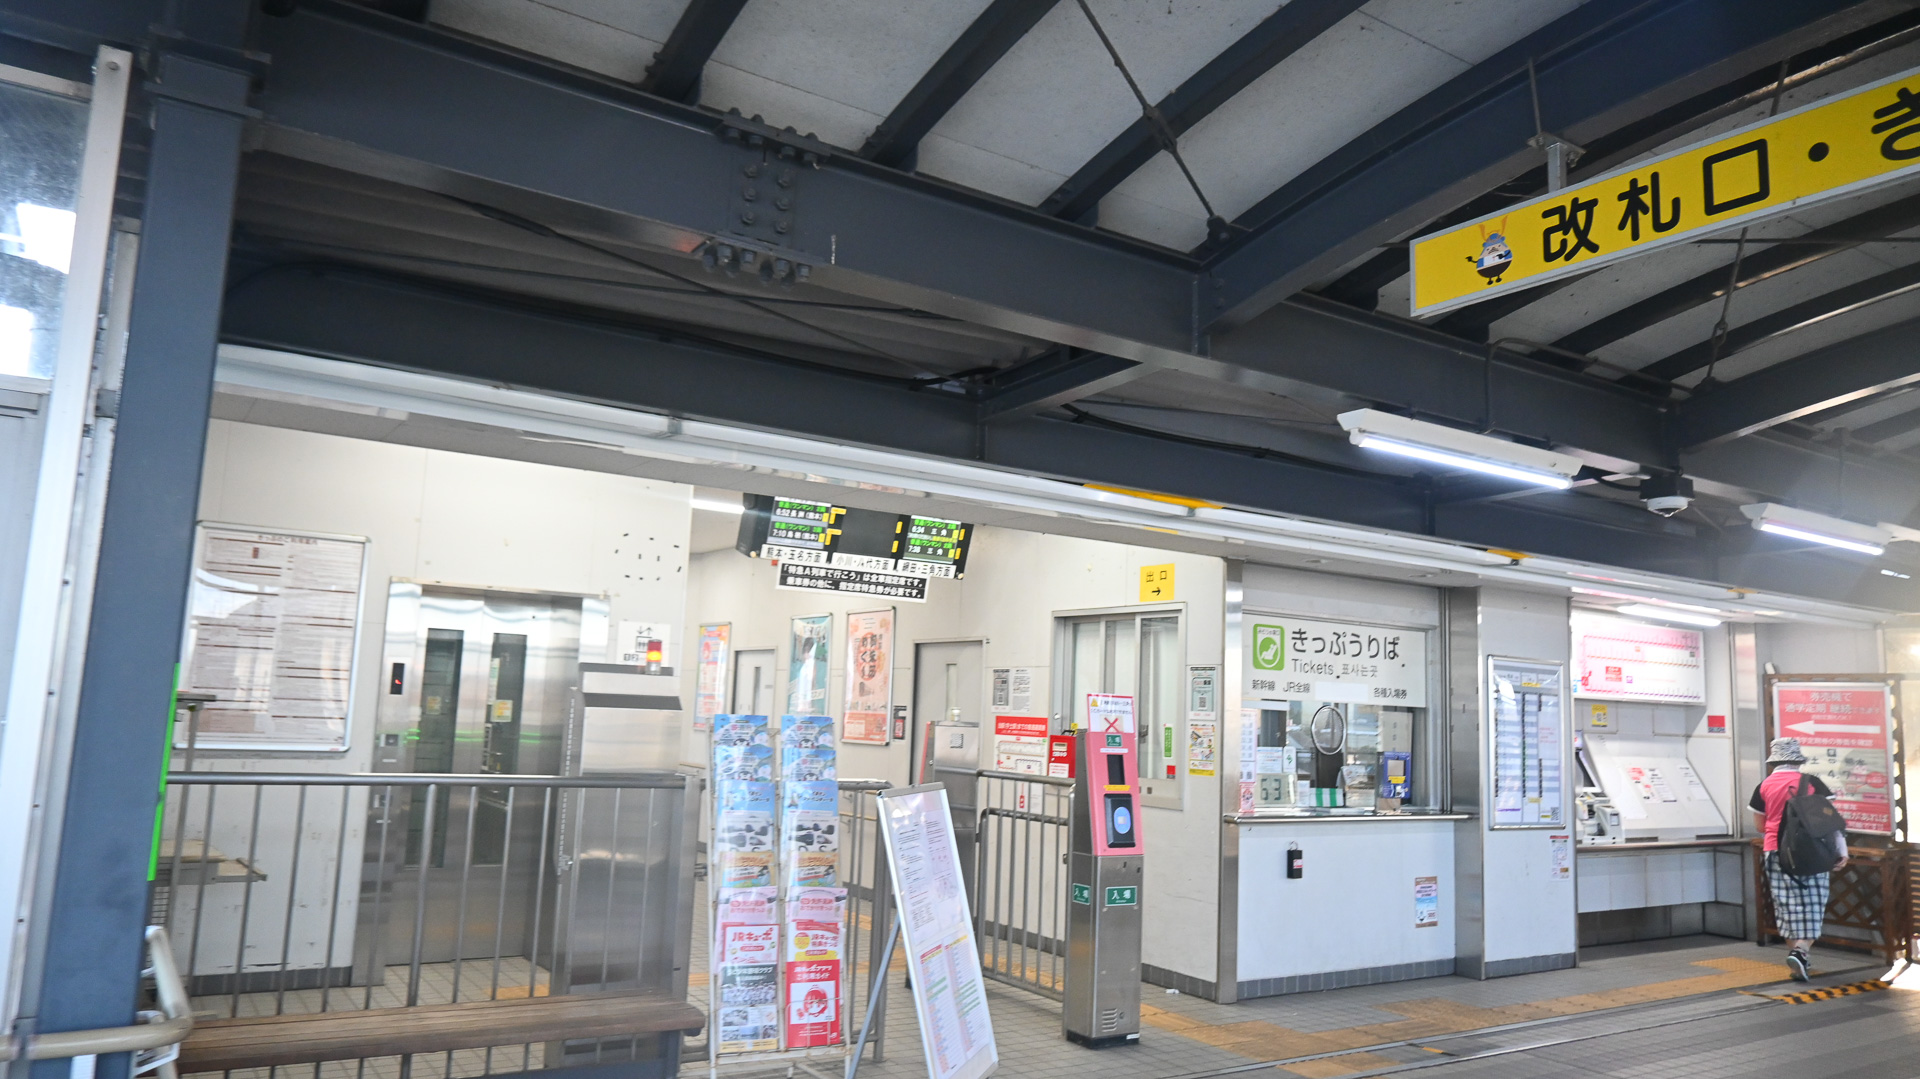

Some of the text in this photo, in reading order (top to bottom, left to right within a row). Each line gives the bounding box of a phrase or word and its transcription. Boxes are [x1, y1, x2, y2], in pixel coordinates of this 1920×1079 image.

[766, 546, 822, 564] 熊本・玉名方面
[836, 554, 890, 571] 小川・八代方面
[1146, 570, 1168, 583] 出口
[1291, 628, 1400, 660] きっぷうりば
[1291, 658, 1334, 676] Tickets
[1252, 679, 1408, 700] 新幹線 JR全線 各種入場券
[1111, 889, 1131, 900] 入場
